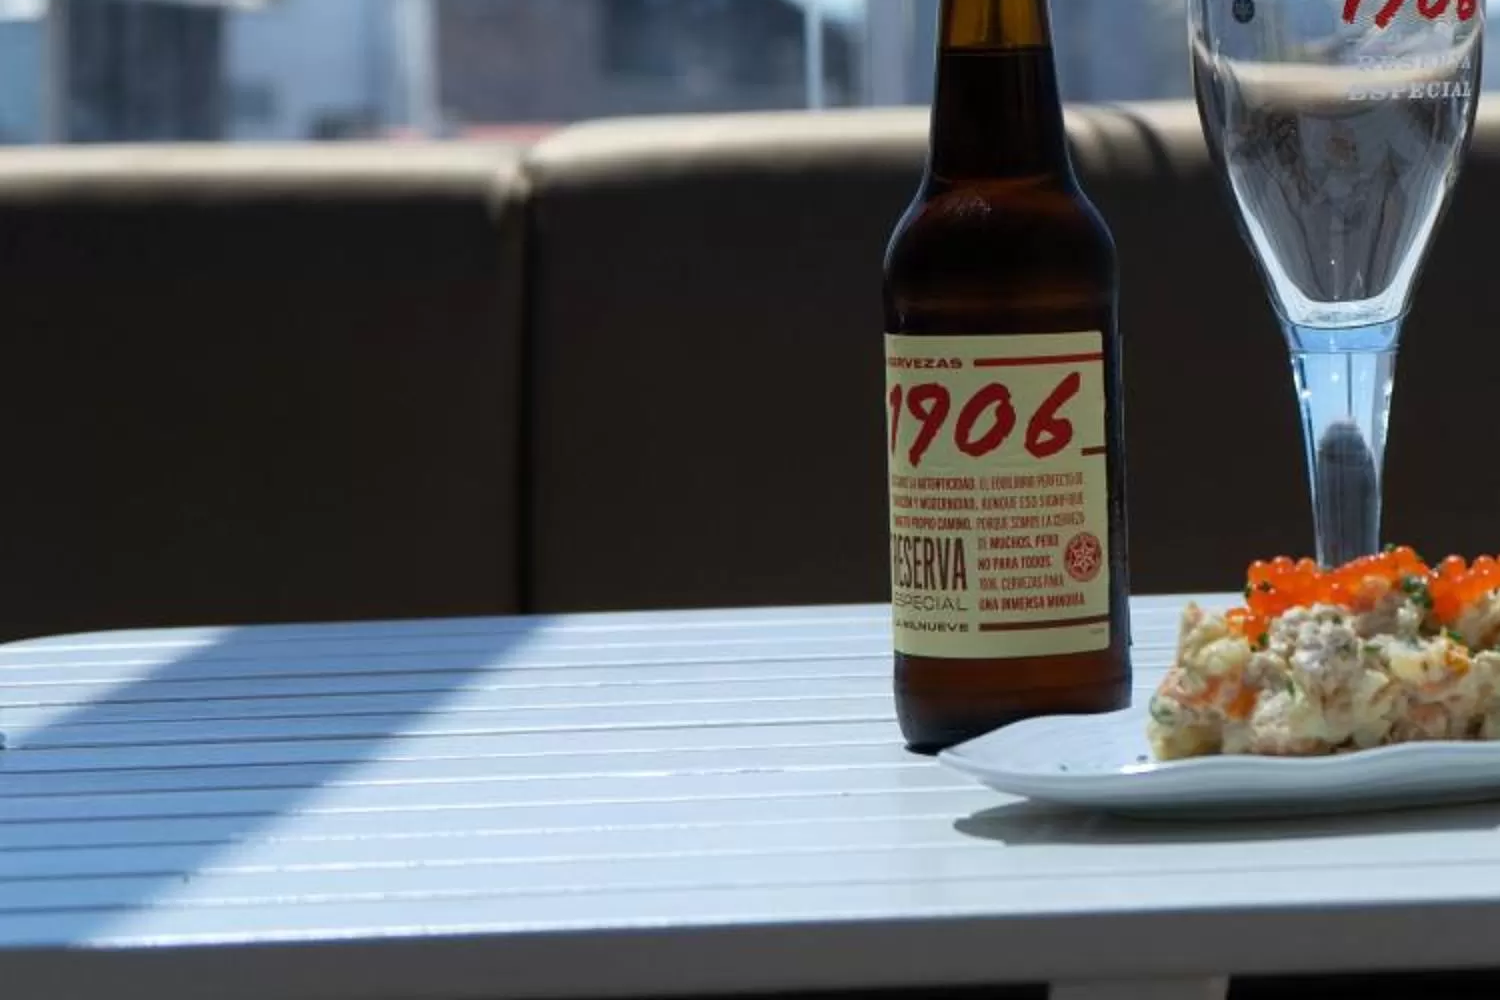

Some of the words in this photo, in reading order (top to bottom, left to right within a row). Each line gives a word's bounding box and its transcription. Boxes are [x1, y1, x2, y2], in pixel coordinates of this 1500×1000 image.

[889, 371, 1081, 468] 1906
[978, 558, 991, 570] NO
[993, 557, 1019, 570] PARA
